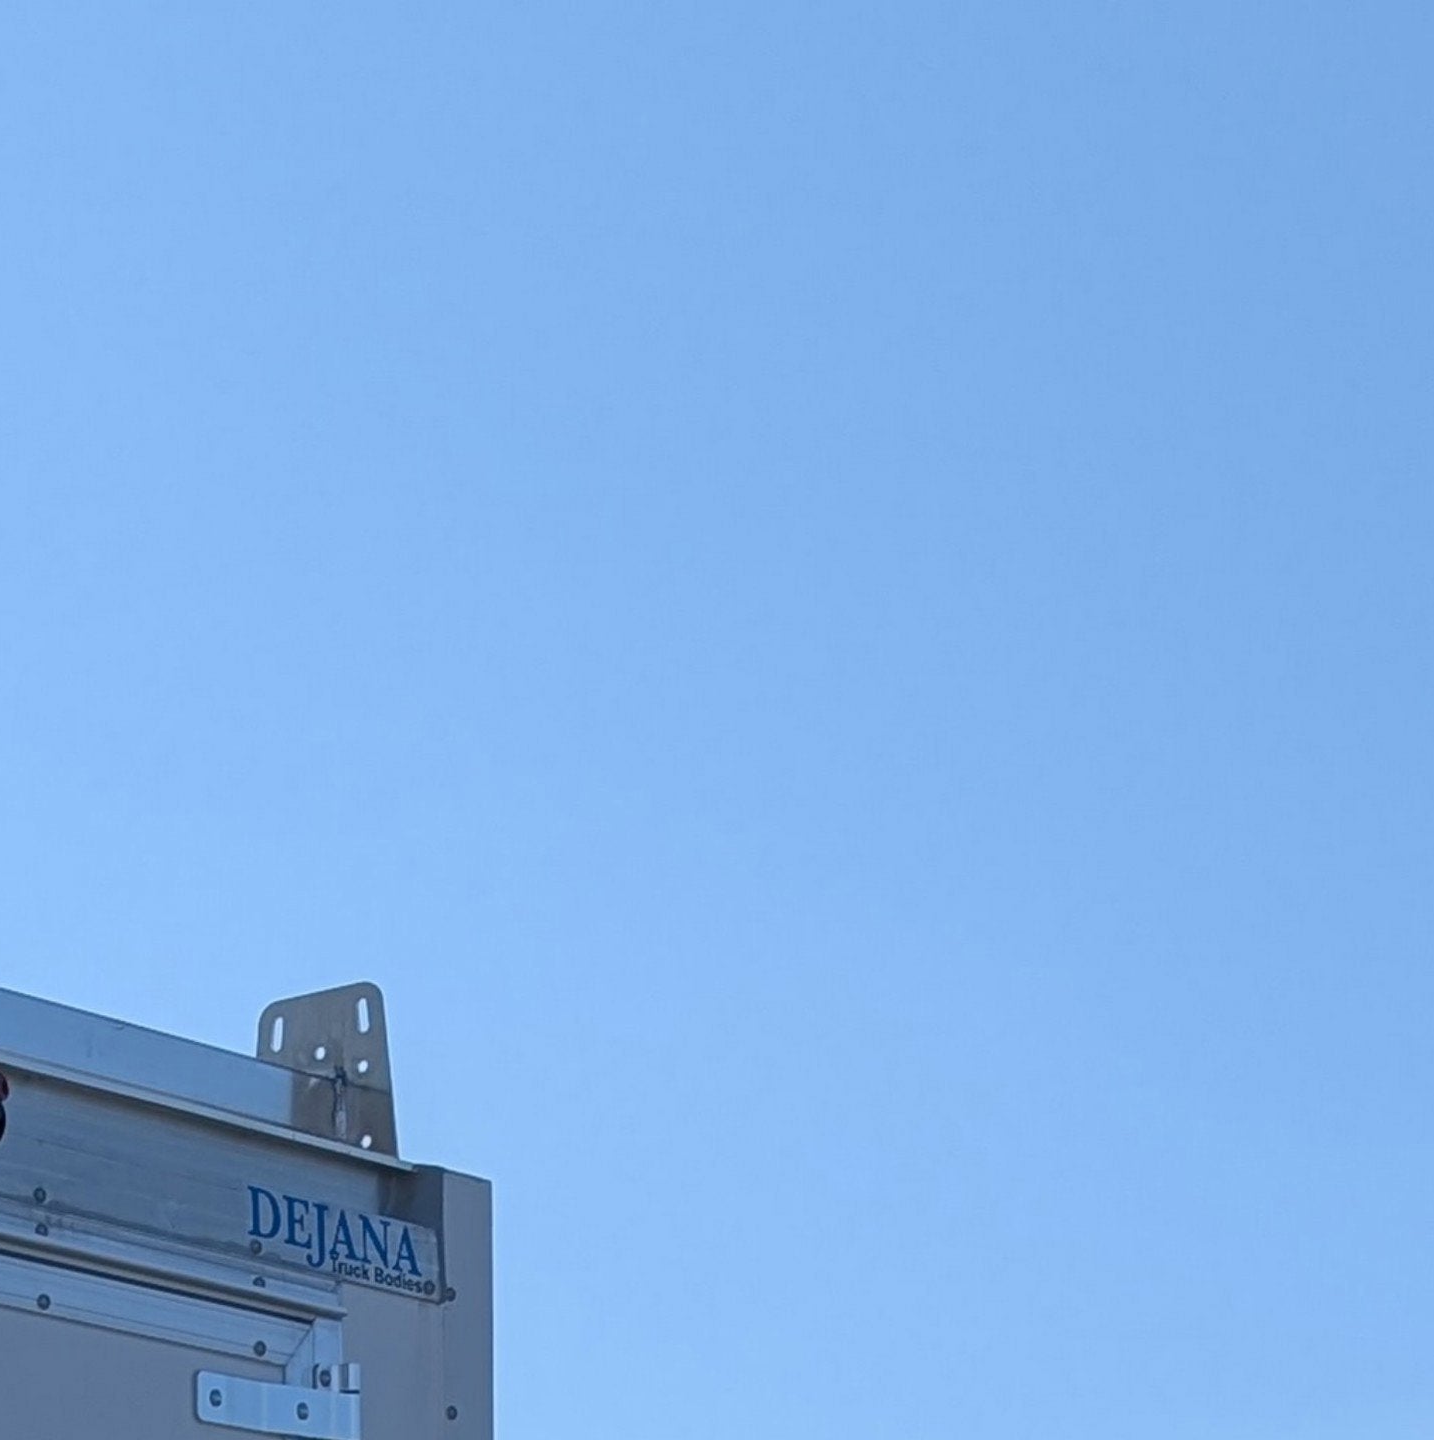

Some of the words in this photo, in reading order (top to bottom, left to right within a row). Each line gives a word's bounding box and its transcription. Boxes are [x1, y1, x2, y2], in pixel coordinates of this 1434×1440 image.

[247, 1185, 422, 1277] DEJANA
[330, 1253, 370, 1281] Truck
[374, 1267, 424, 1293] Bodies
